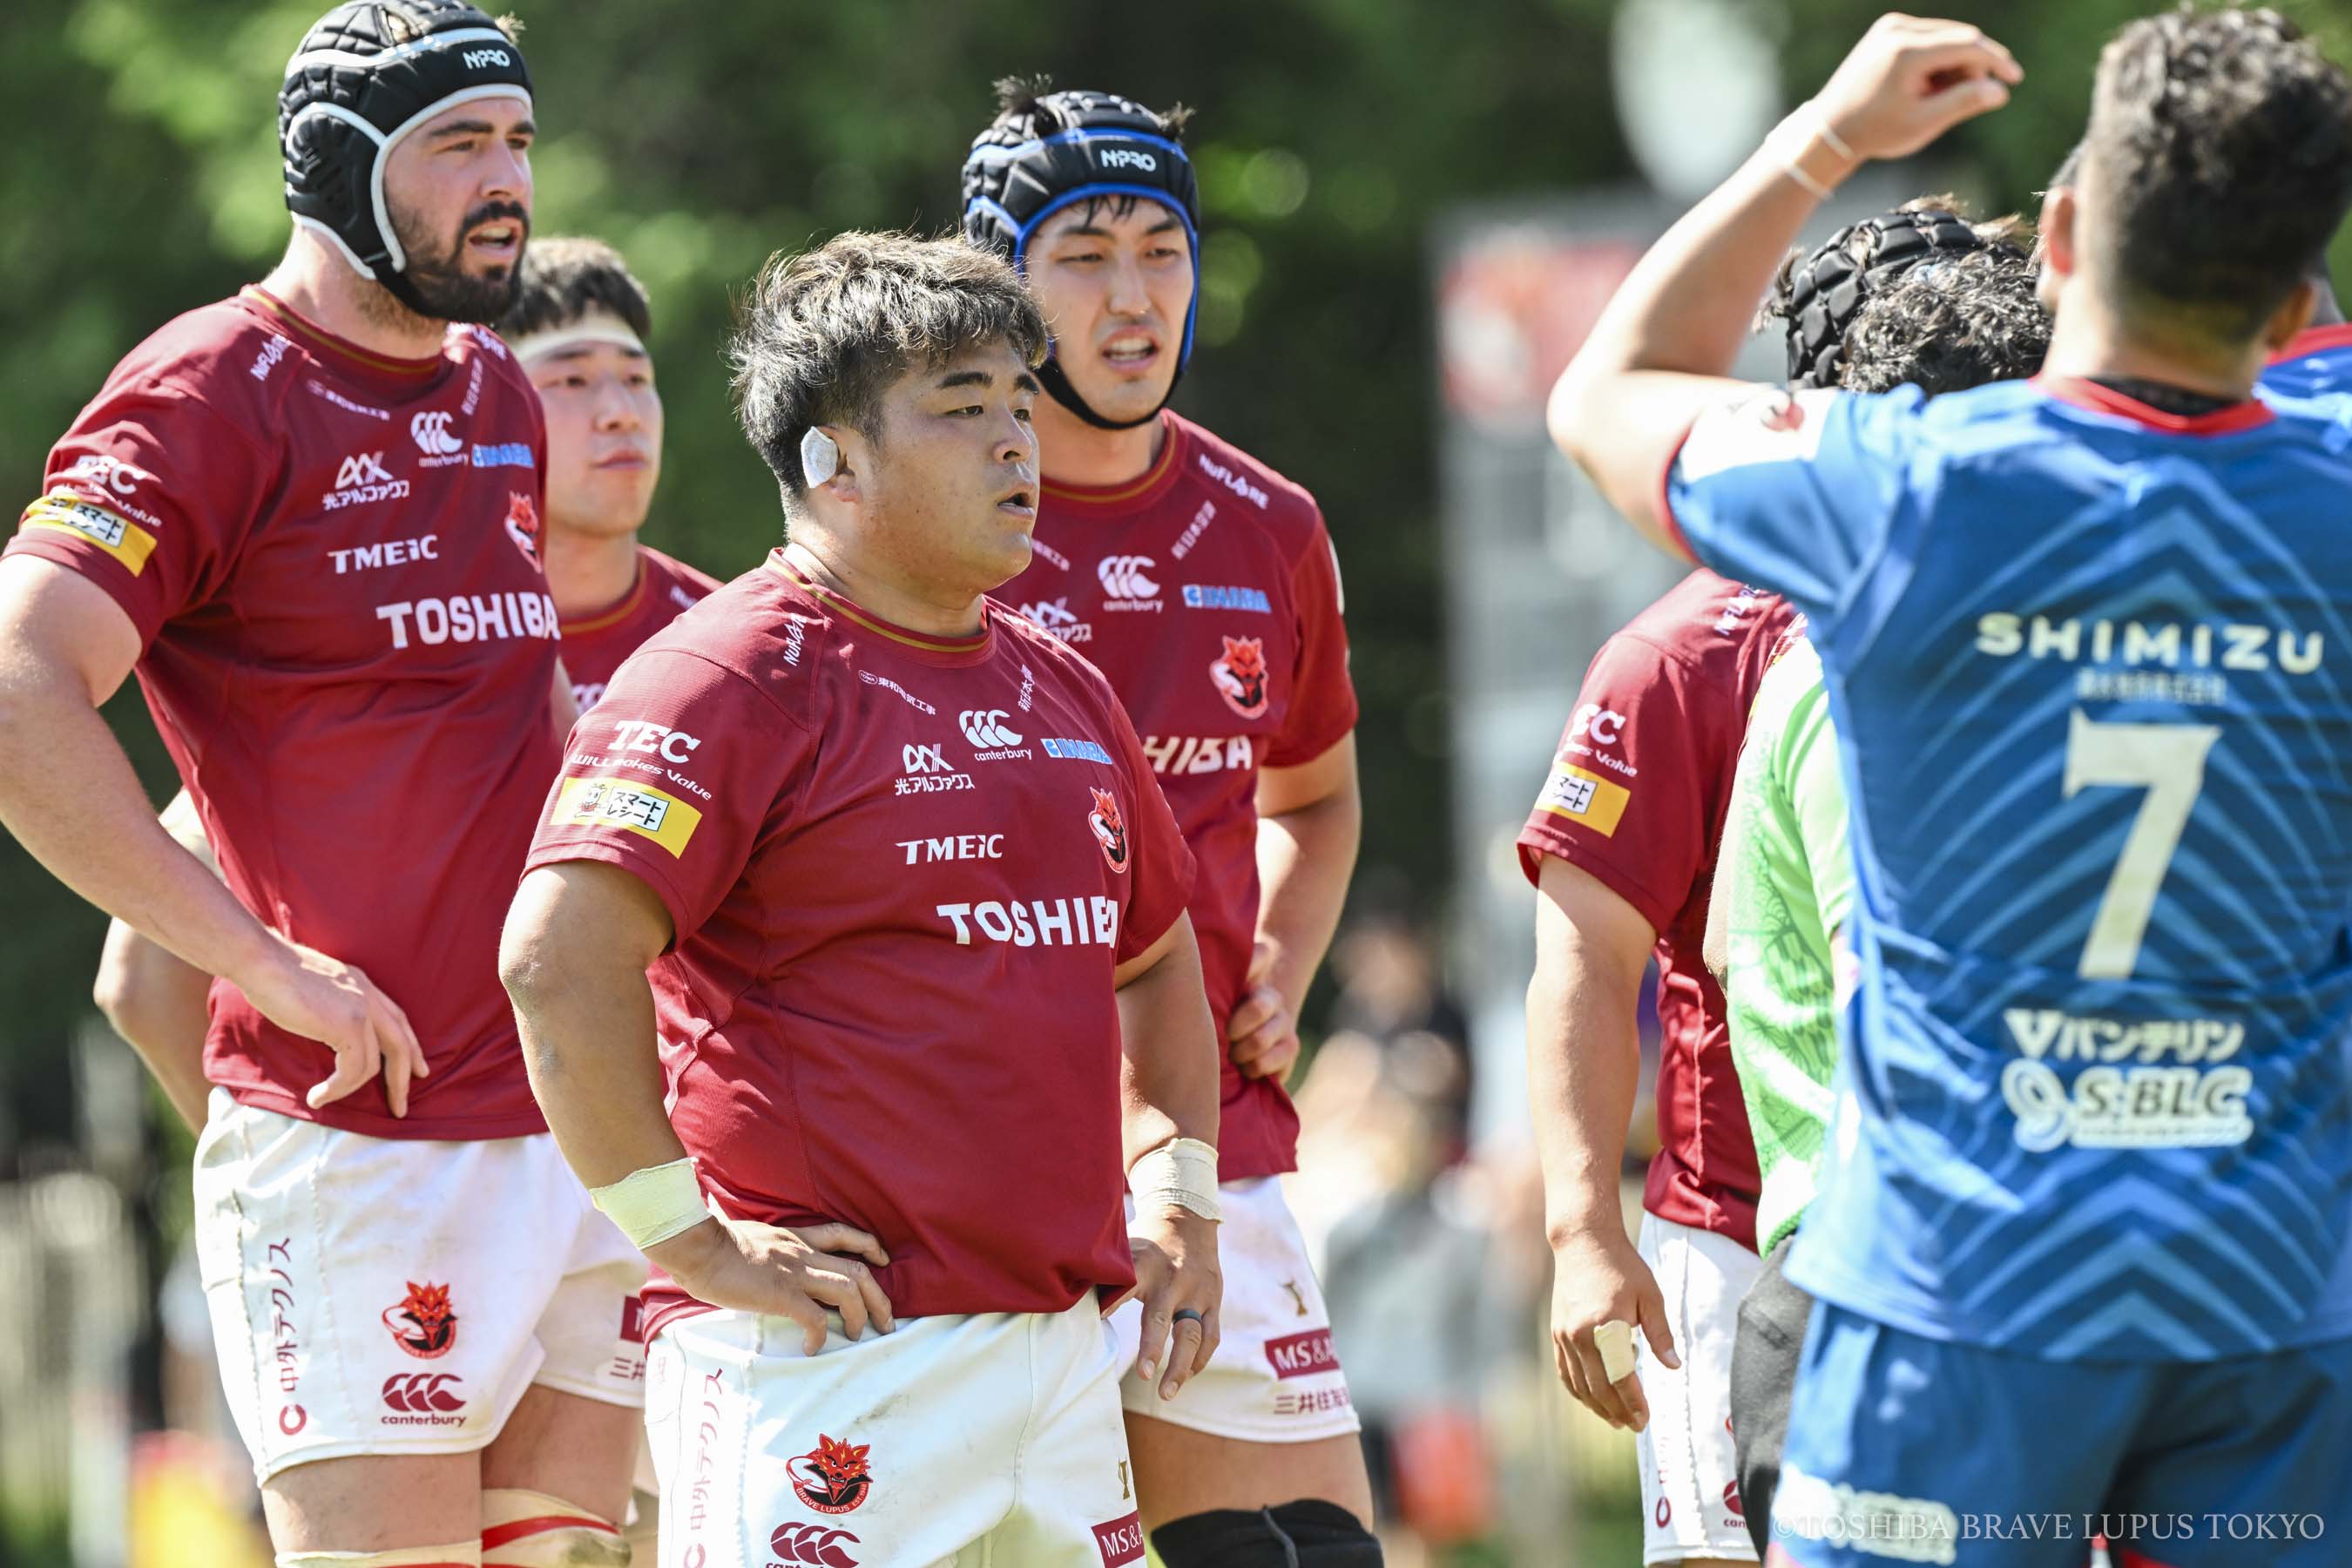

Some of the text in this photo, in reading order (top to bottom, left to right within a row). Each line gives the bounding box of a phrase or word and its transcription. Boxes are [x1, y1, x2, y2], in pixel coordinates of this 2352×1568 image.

[375, 591, 562, 649] TOSHIBA
[1975, 612, 2325, 674] SHIMIZU
[607, 720, 702, 764] TEC
[974, 748, 1032, 762] canterbury
[1143, 735, 1253, 774] HIBA
[667, 768, 712, 801] Value
[895, 774, 976, 796] 光アルファクス
[606, 805, 656, 826] レシート
[617, 791, 662, 814] スマート
[2063, 706, 2224, 981] 7
[268, 1238, 301, 1392] 中外テクノス
[381, 1413, 468, 1428] canterbury
[796, 1487, 819, 1510] BRAVE
[821, 1504, 850, 1513] LUPUS
